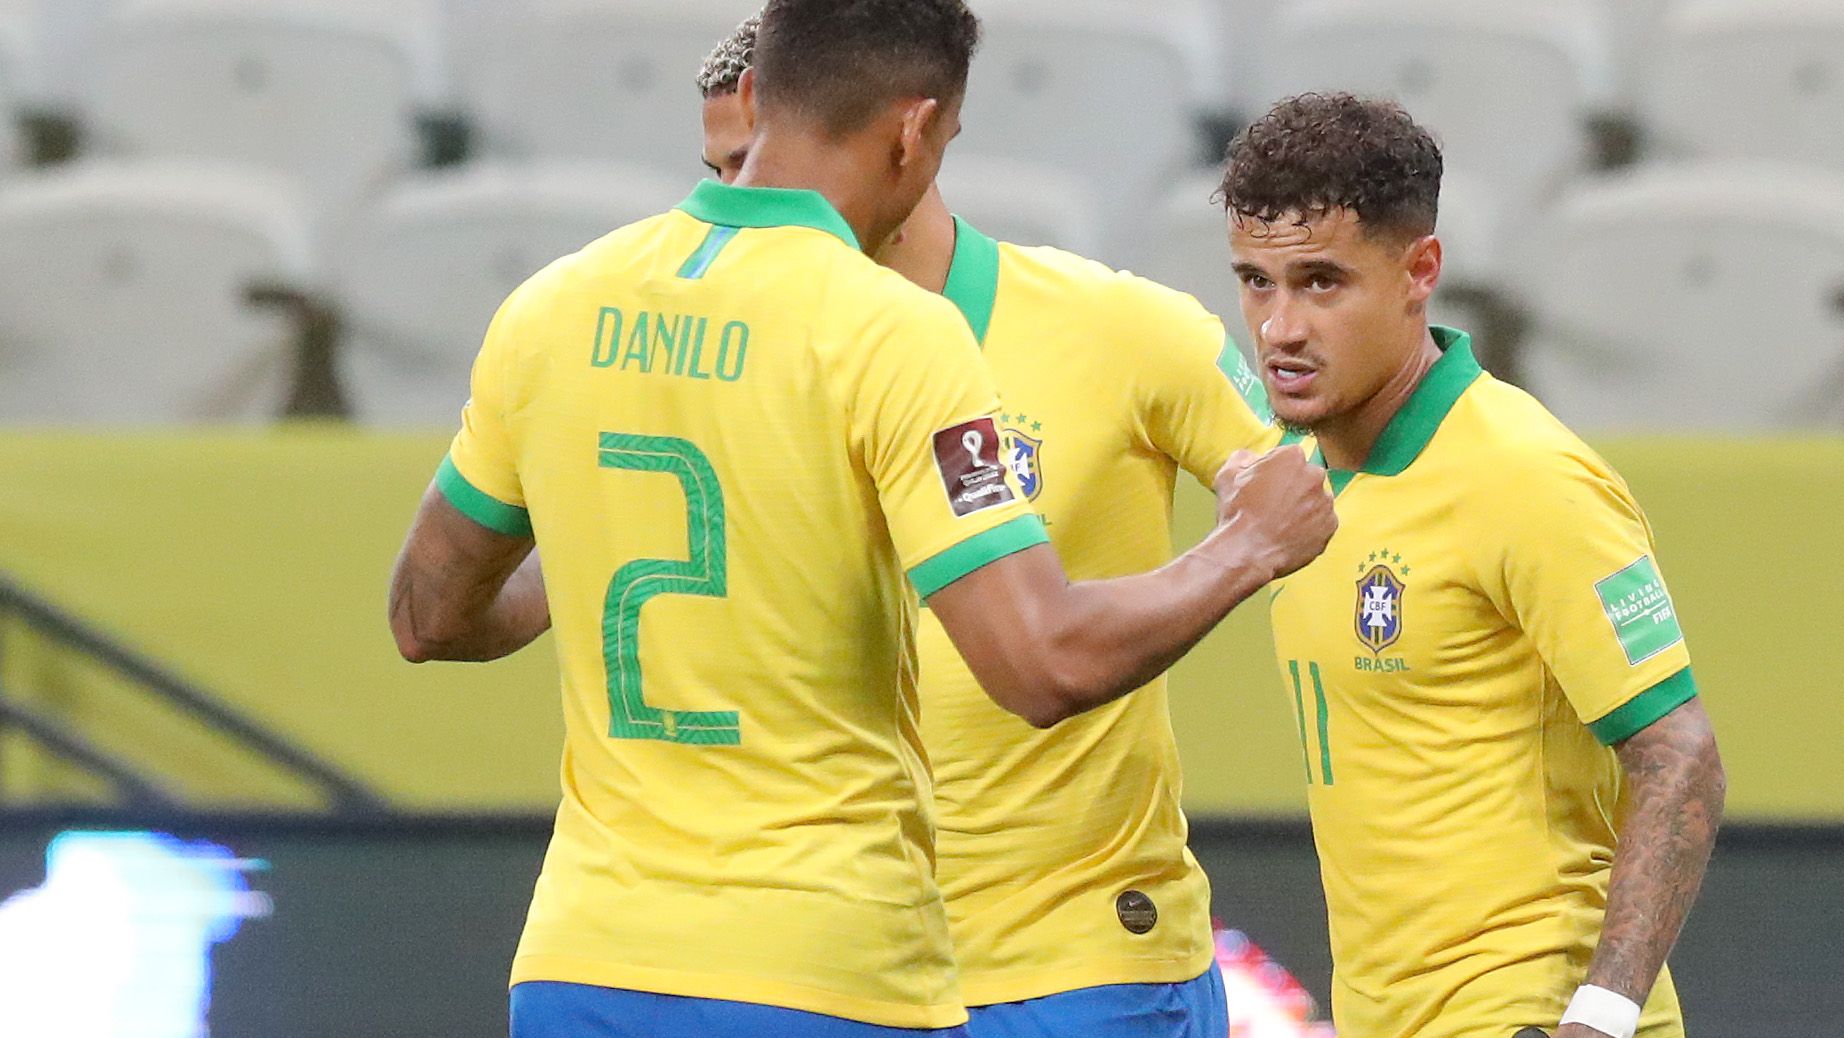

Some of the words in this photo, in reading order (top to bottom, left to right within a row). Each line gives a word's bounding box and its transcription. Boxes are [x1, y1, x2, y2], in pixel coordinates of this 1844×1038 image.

[591, 306, 750, 382] DANILO
[598, 431, 740, 746] 2
[1369, 601, 1386, 611] CBF
[1354, 656, 1410, 673] BRASIL
